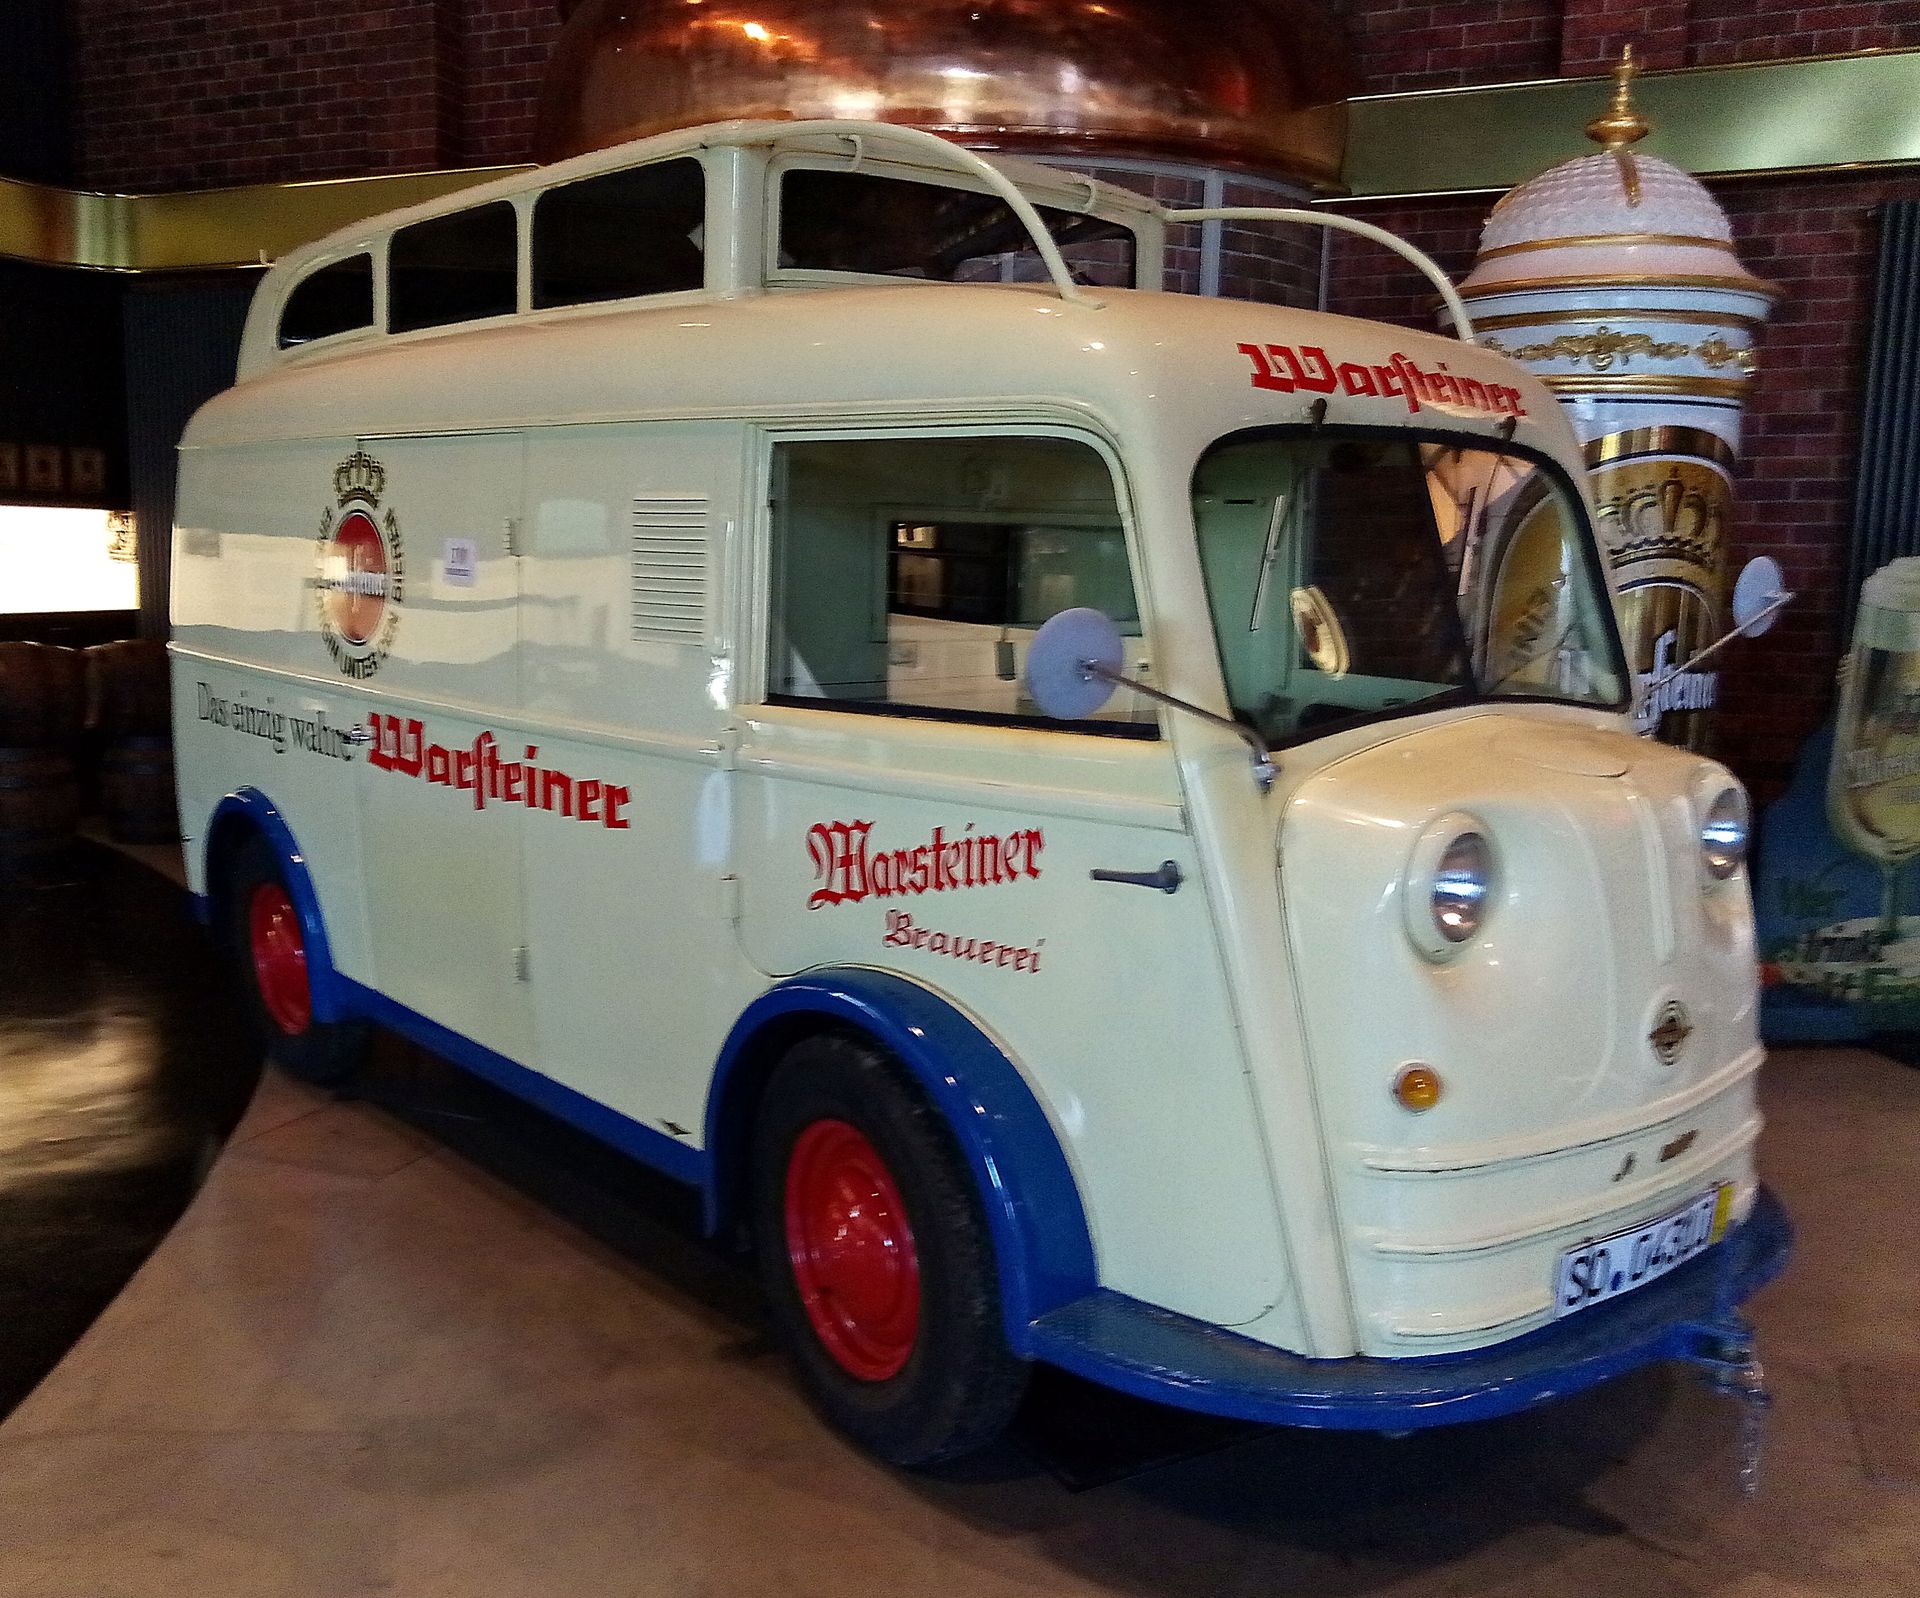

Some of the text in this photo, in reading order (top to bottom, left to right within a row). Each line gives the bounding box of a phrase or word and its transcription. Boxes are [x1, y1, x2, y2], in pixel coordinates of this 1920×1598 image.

[1236, 342, 1528, 417] Warsteiner
[196, 681, 632, 829] Das einzig wahre Warsteiner
[805, 818, 1047, 911] Warsteiner
[882, 908, 1046, 974] Brauerei
